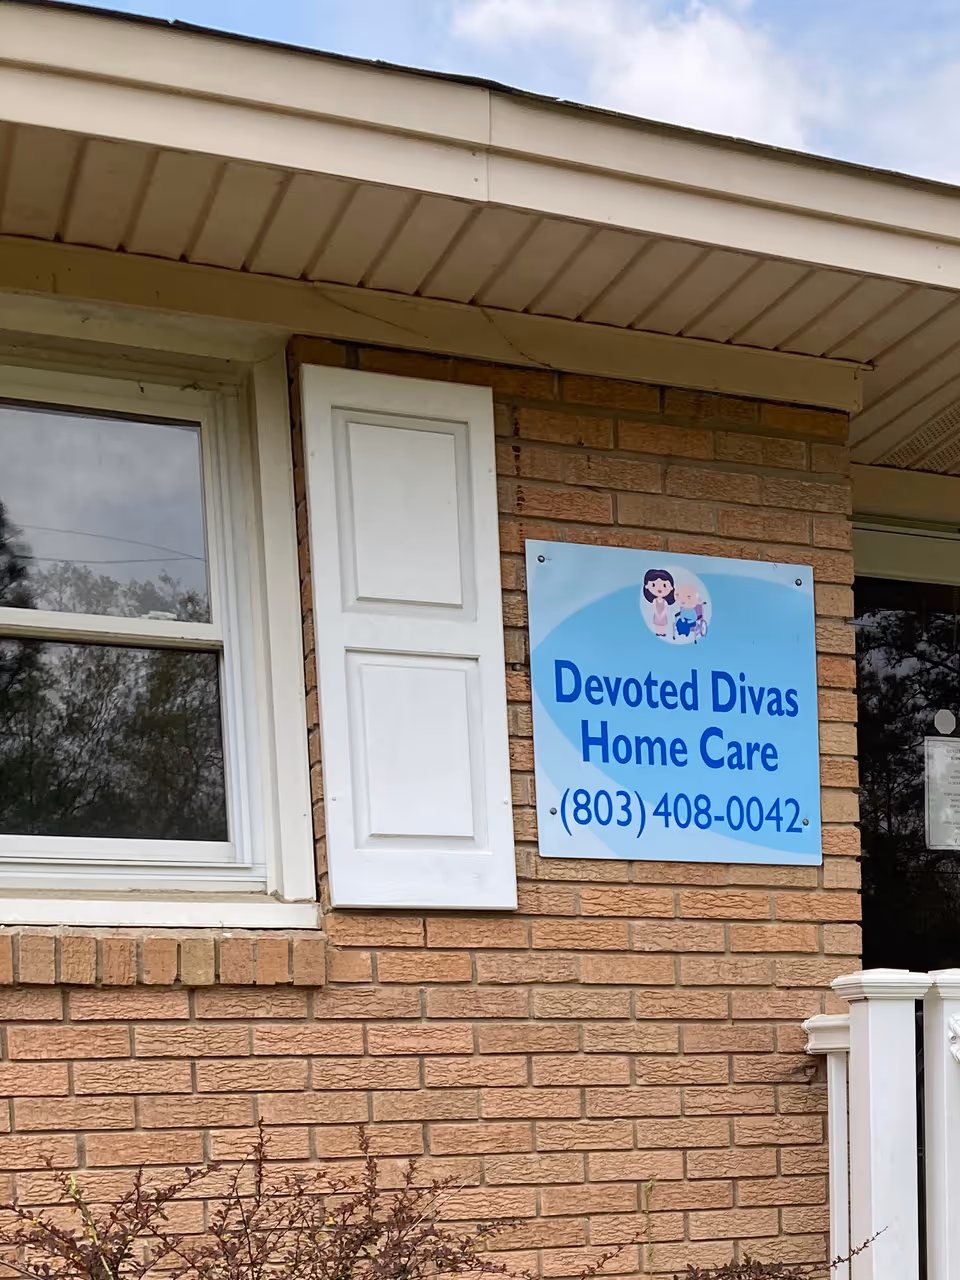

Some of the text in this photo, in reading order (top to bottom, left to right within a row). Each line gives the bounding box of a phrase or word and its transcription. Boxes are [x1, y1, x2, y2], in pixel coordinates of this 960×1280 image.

[554, 659, 799, 718] Devoted Divas
[581, 719, 779, 772] Home Care
[560, 787, 803, 839] (803) 408-0042
